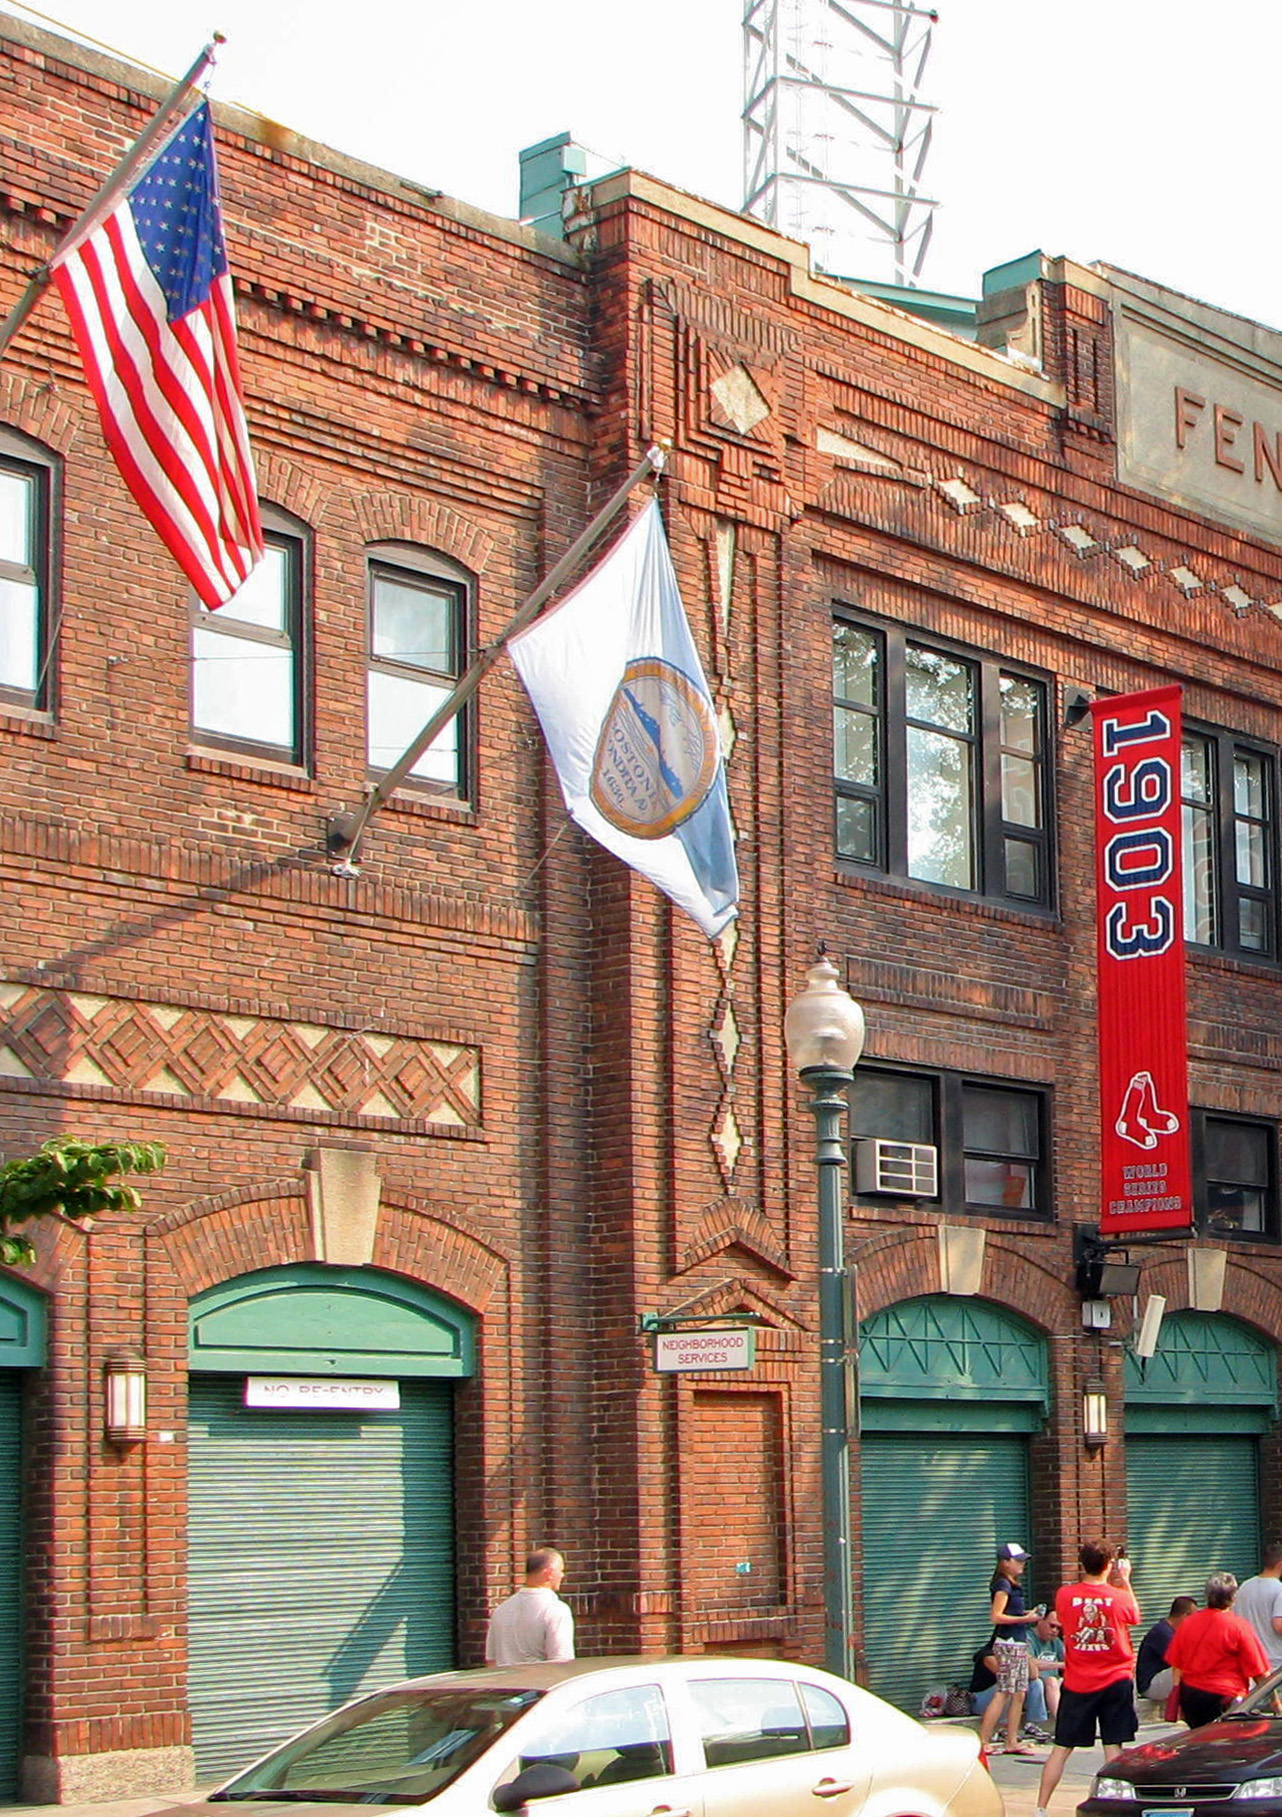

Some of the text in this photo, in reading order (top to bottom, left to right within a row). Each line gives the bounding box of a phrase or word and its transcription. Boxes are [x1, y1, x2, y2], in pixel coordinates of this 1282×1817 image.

[1101, 709, 1175, 960] 1903
[1122, 1162, 1168, 1180] WORLD
[1109, 1196, 1182, 1215] CHAMPIONS
[662, 1336, 744, 1351] NEIGHBORHOOD
[677, 1352, 728, 1364] SERVICES
[263, 1384, 384, 1400] NO RE-ENTRY
[1072, 1596, 1113, 1607] BEAT
